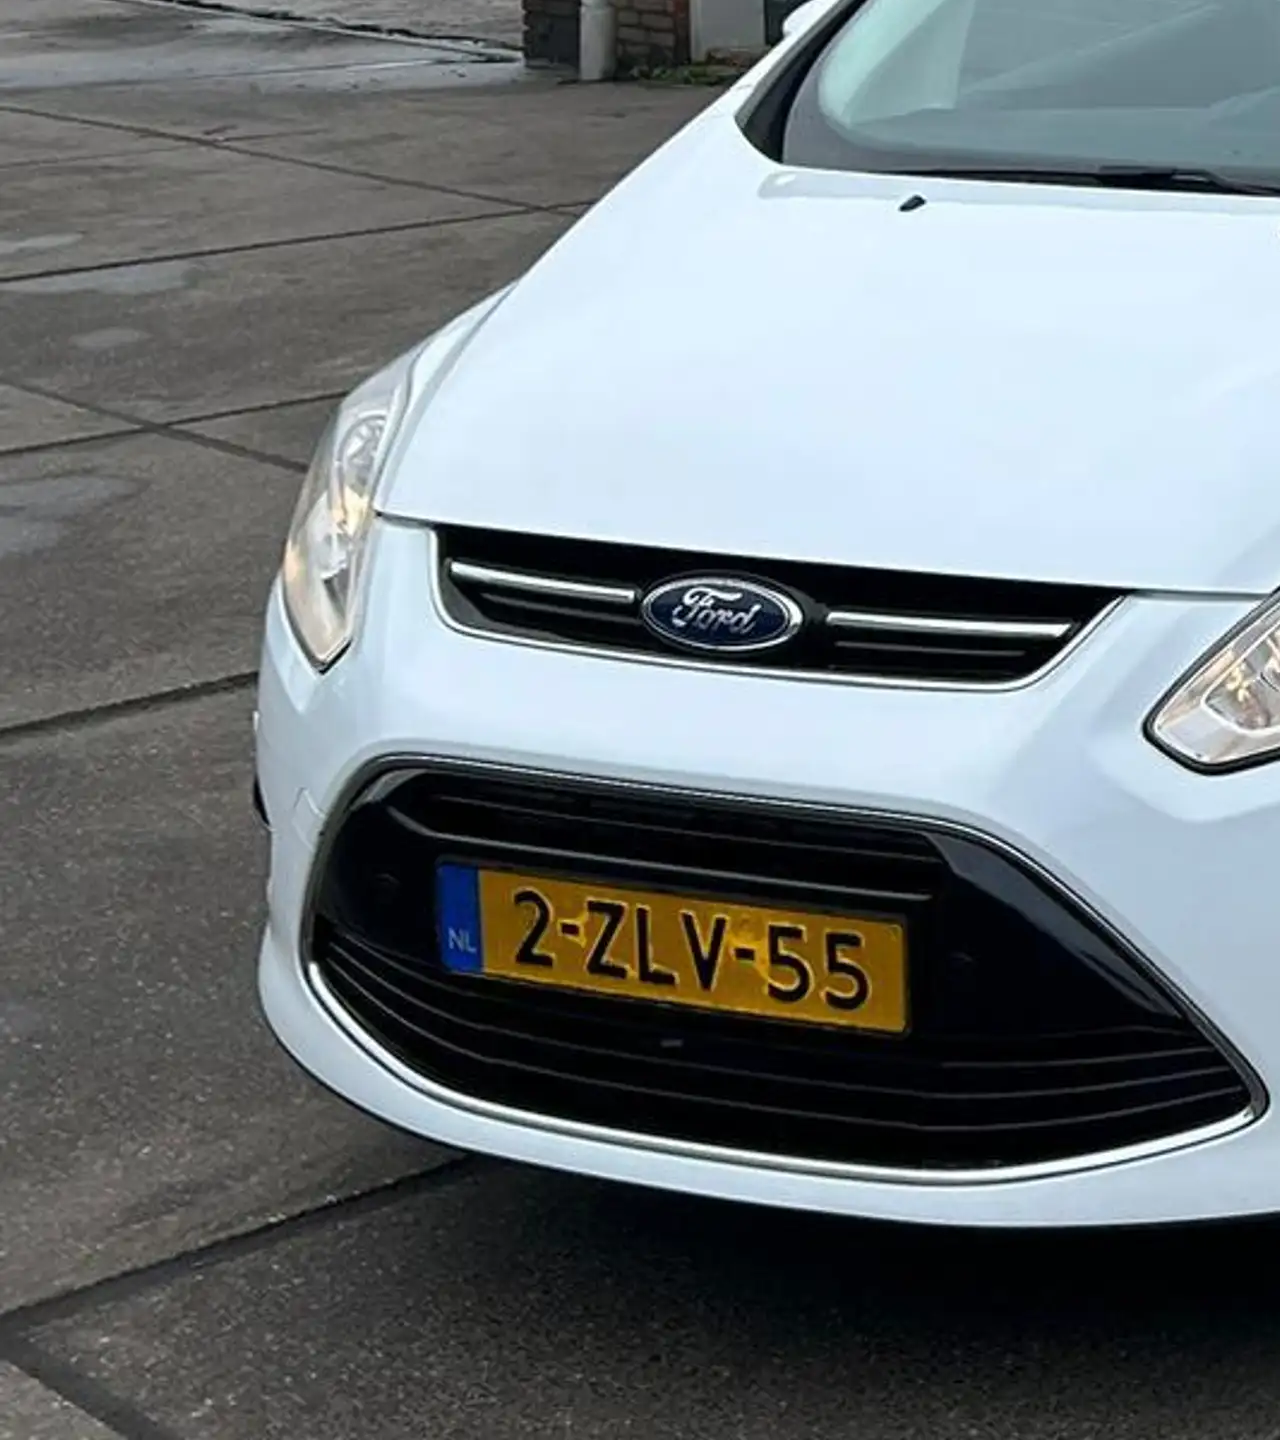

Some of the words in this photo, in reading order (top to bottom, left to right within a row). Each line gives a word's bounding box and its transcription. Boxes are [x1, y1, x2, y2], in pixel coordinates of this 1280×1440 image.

[670, 586, 762, 637] Ford
[447, 929, 477, 955] NL
[512, 889, 871, 1011] 2-ZLV-55
